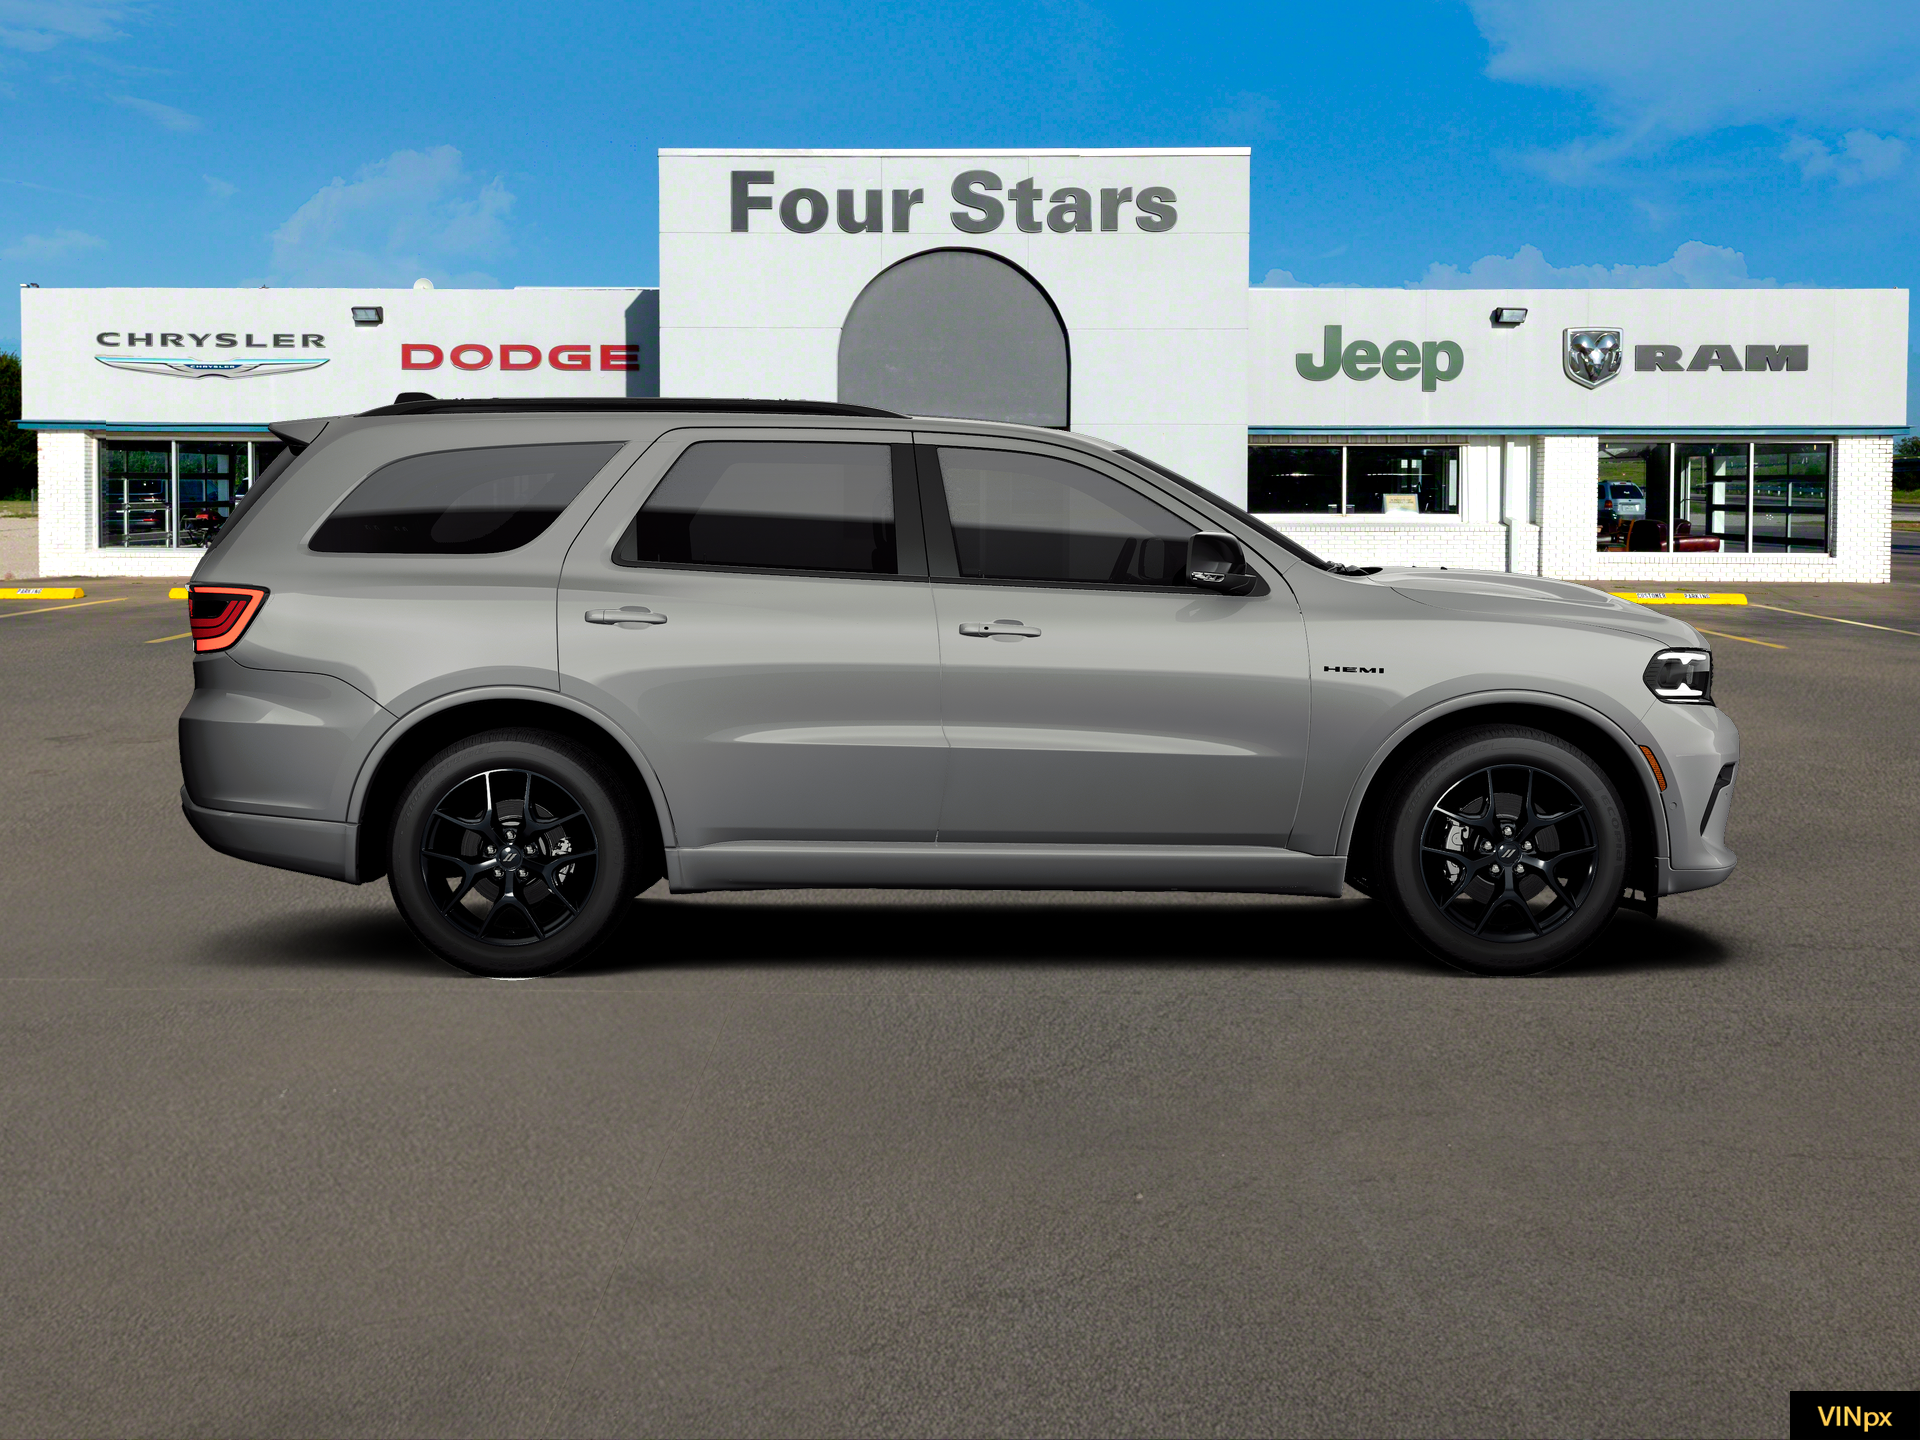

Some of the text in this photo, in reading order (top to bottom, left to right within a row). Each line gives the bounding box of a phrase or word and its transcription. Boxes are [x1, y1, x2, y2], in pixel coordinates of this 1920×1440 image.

[730, 169, 1178, 234] Four Stars
[96, 332, 326, 348] CHRYSLER
[401, 343, 640, 371] DODGE
[1296, 325, 1464, 392] Jeep
[1635, 344, 1809, 372] RAM
[1323, 666, 1385, 674] HEMI
